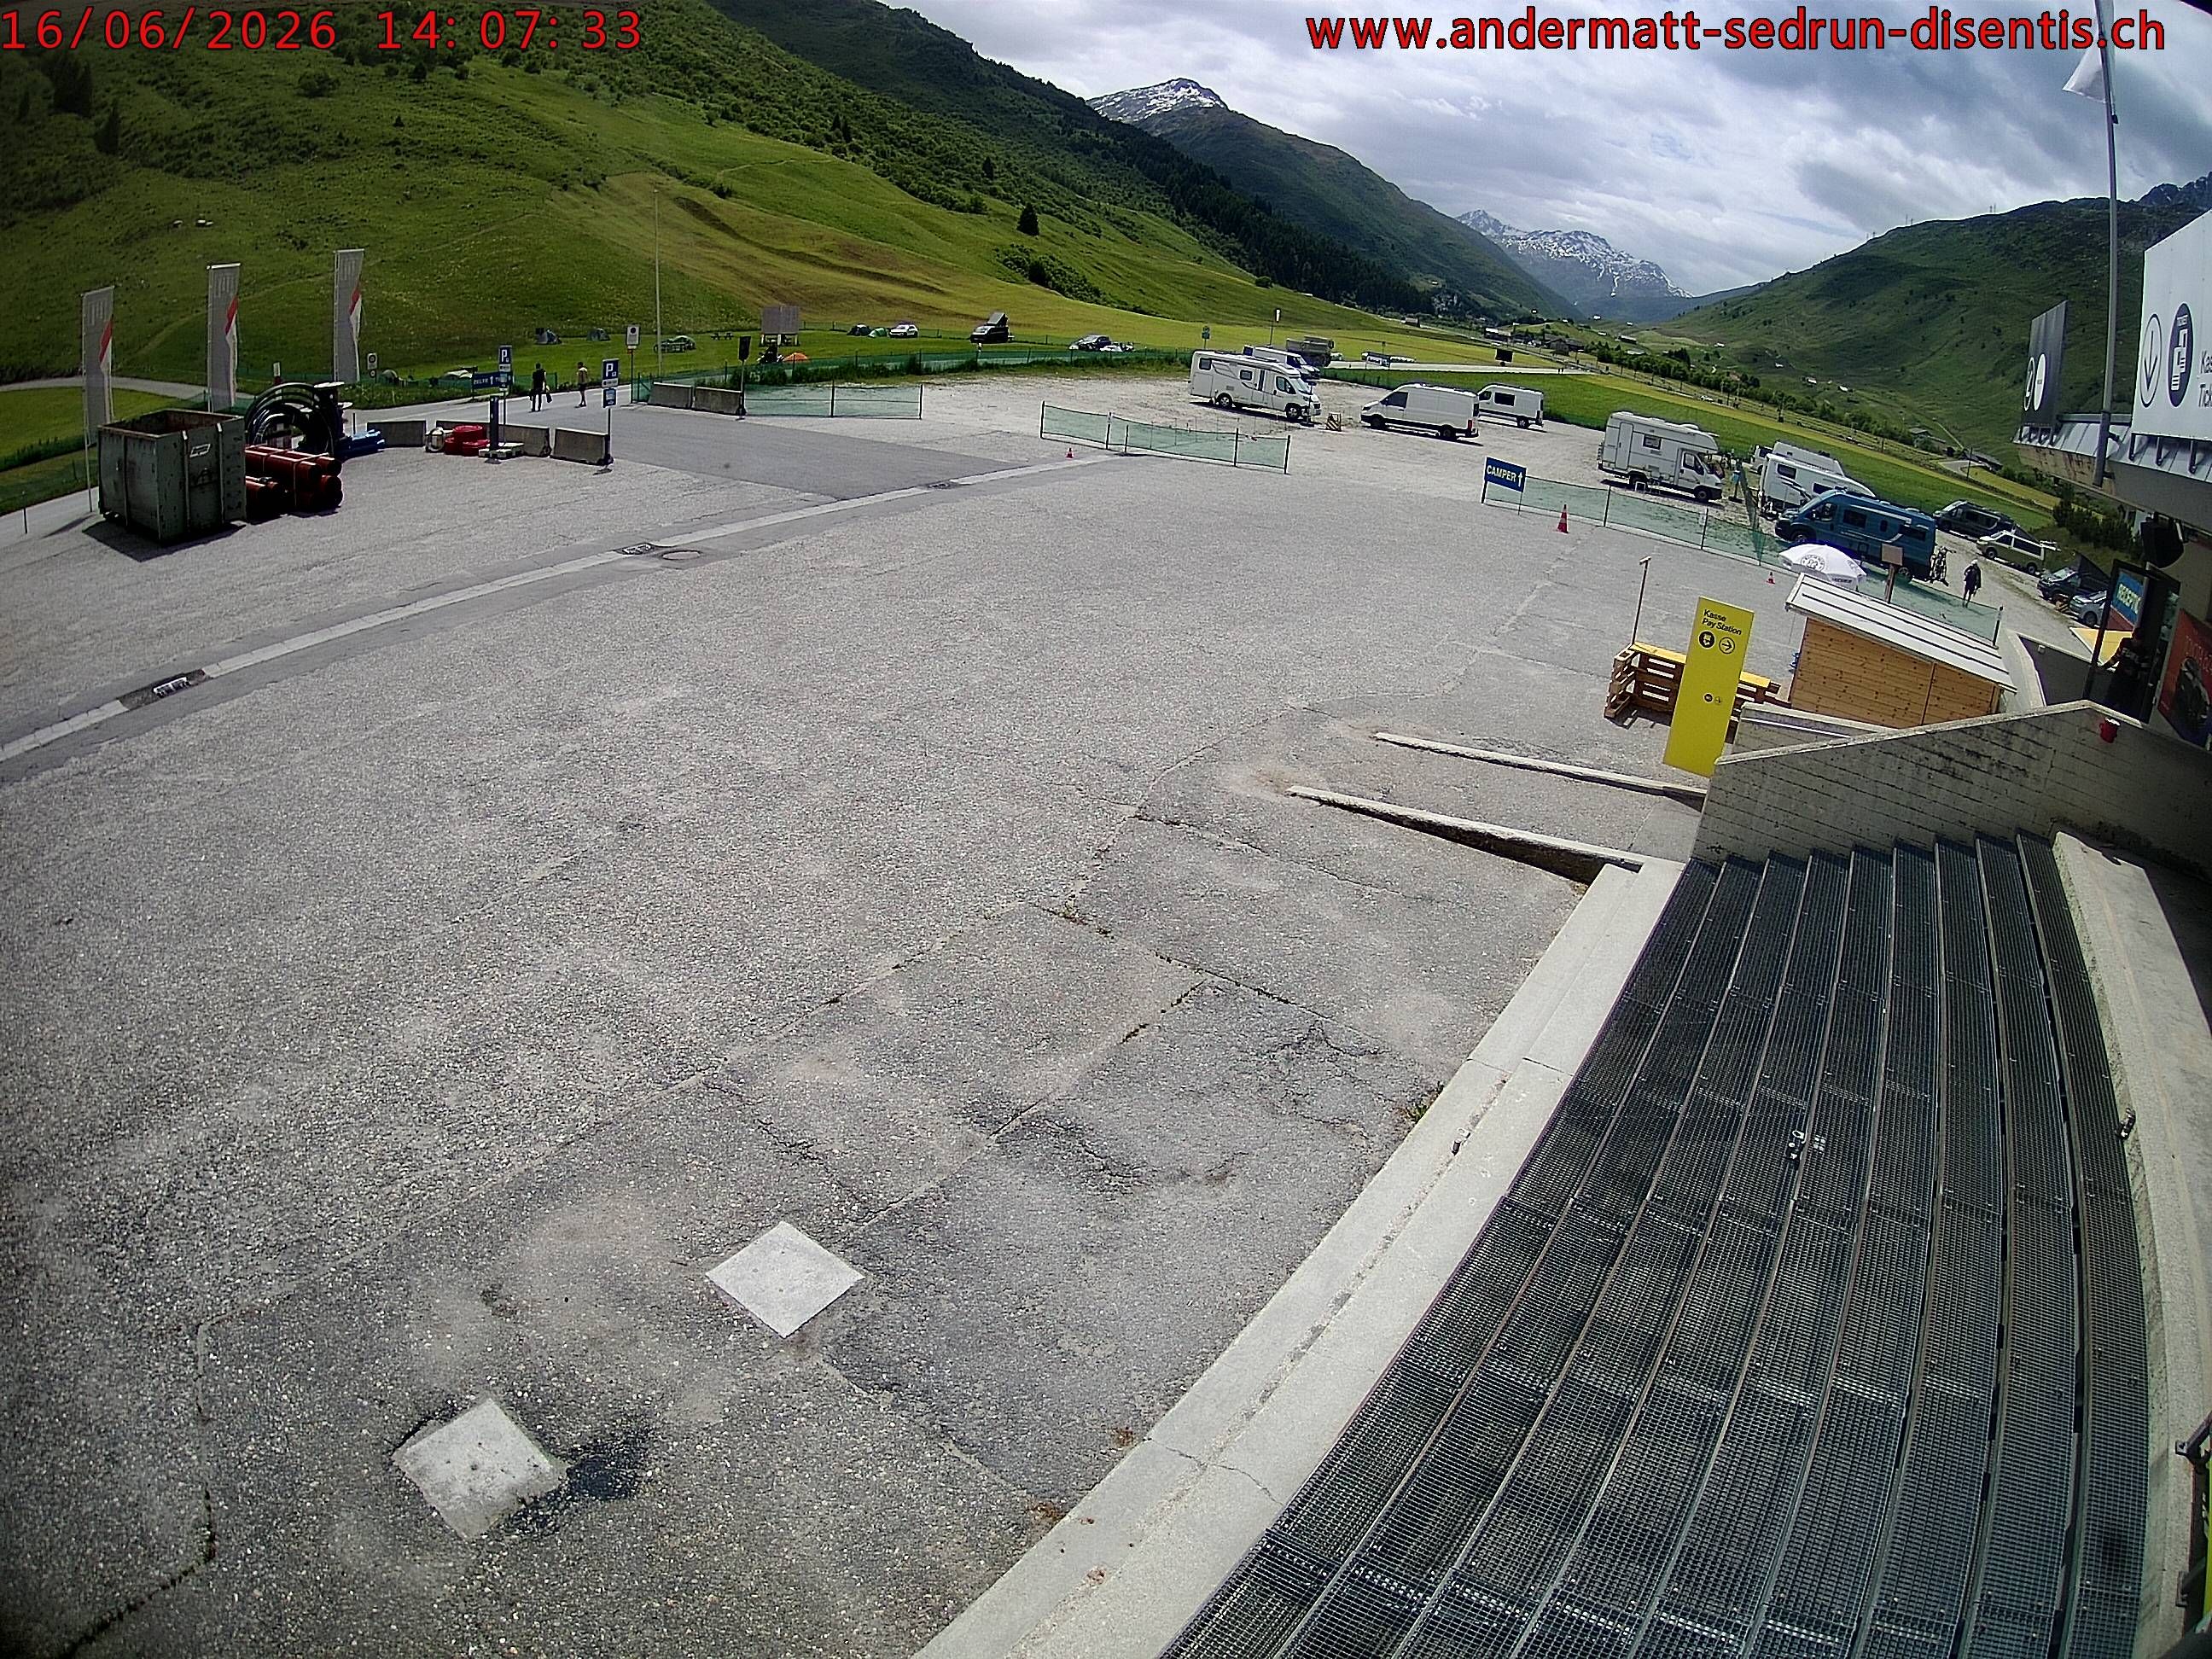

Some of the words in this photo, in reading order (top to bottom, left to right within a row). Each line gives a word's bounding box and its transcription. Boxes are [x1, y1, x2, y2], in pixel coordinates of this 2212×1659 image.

[501, 349, 508, 363] P
[606, 363, 614, 377] P
[1487, 465, 1516, 482] CAMPER
[1703, 608, 1727, 622] Kasse
[1702, 617, 1716, 628] Pay
[1716, 622, 1742, 636] Station
